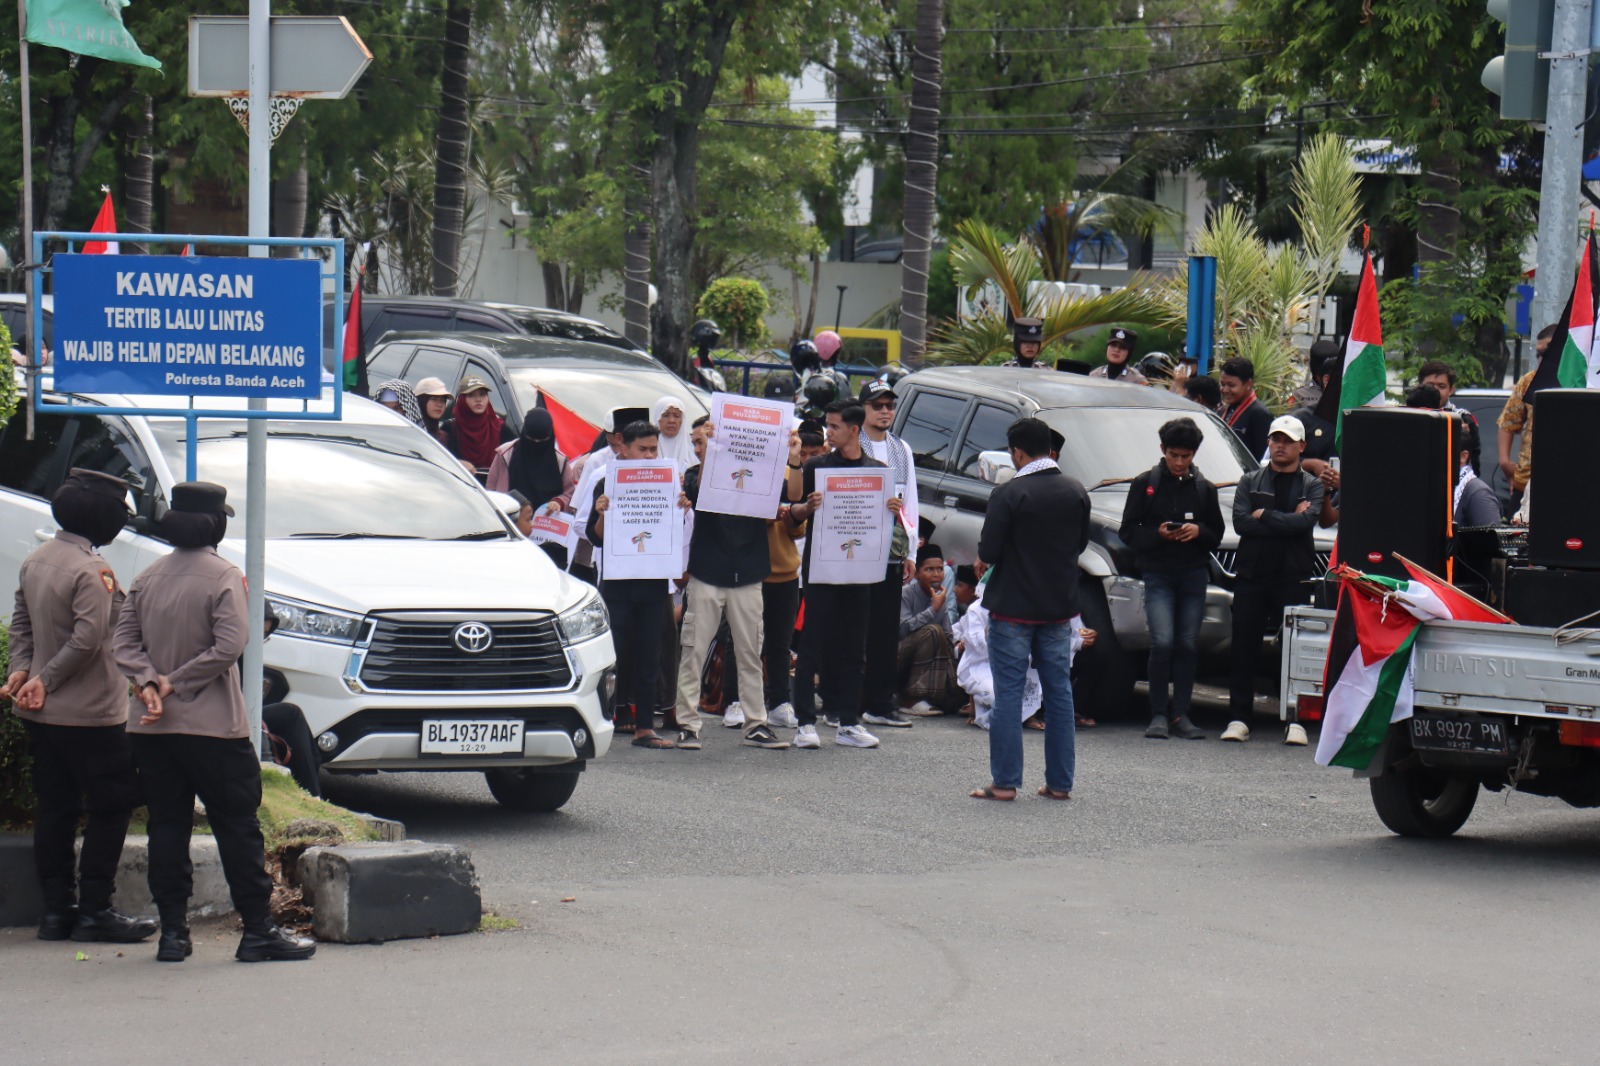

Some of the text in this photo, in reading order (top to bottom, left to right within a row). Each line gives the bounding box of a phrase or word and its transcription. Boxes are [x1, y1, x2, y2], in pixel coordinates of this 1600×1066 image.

[116, 271, 253, 299] KAWASAN
[104, 307, 264, 332] TERTIB LALU LINTAS
[63, 340, 305, 368] WAJIB HELM DEPAN BELAKANG
[165, 372, 305, 388] Polresta Banda Aceh
[742, 427, 777, 437] KEUADILAN
[730, 441, 765, 450] KEUADILAN
[734, 455, 756, 463] TEUKA.
[1422, 652, 1517, 677] IHATSU
[1565, 667, 1588, 678] Gran
[428, 724, 519, 742] BL 1937 AAF
[1413, 719, 1501, 743] BK 8922 PM
[460, 744, 486, 752] 12-29
